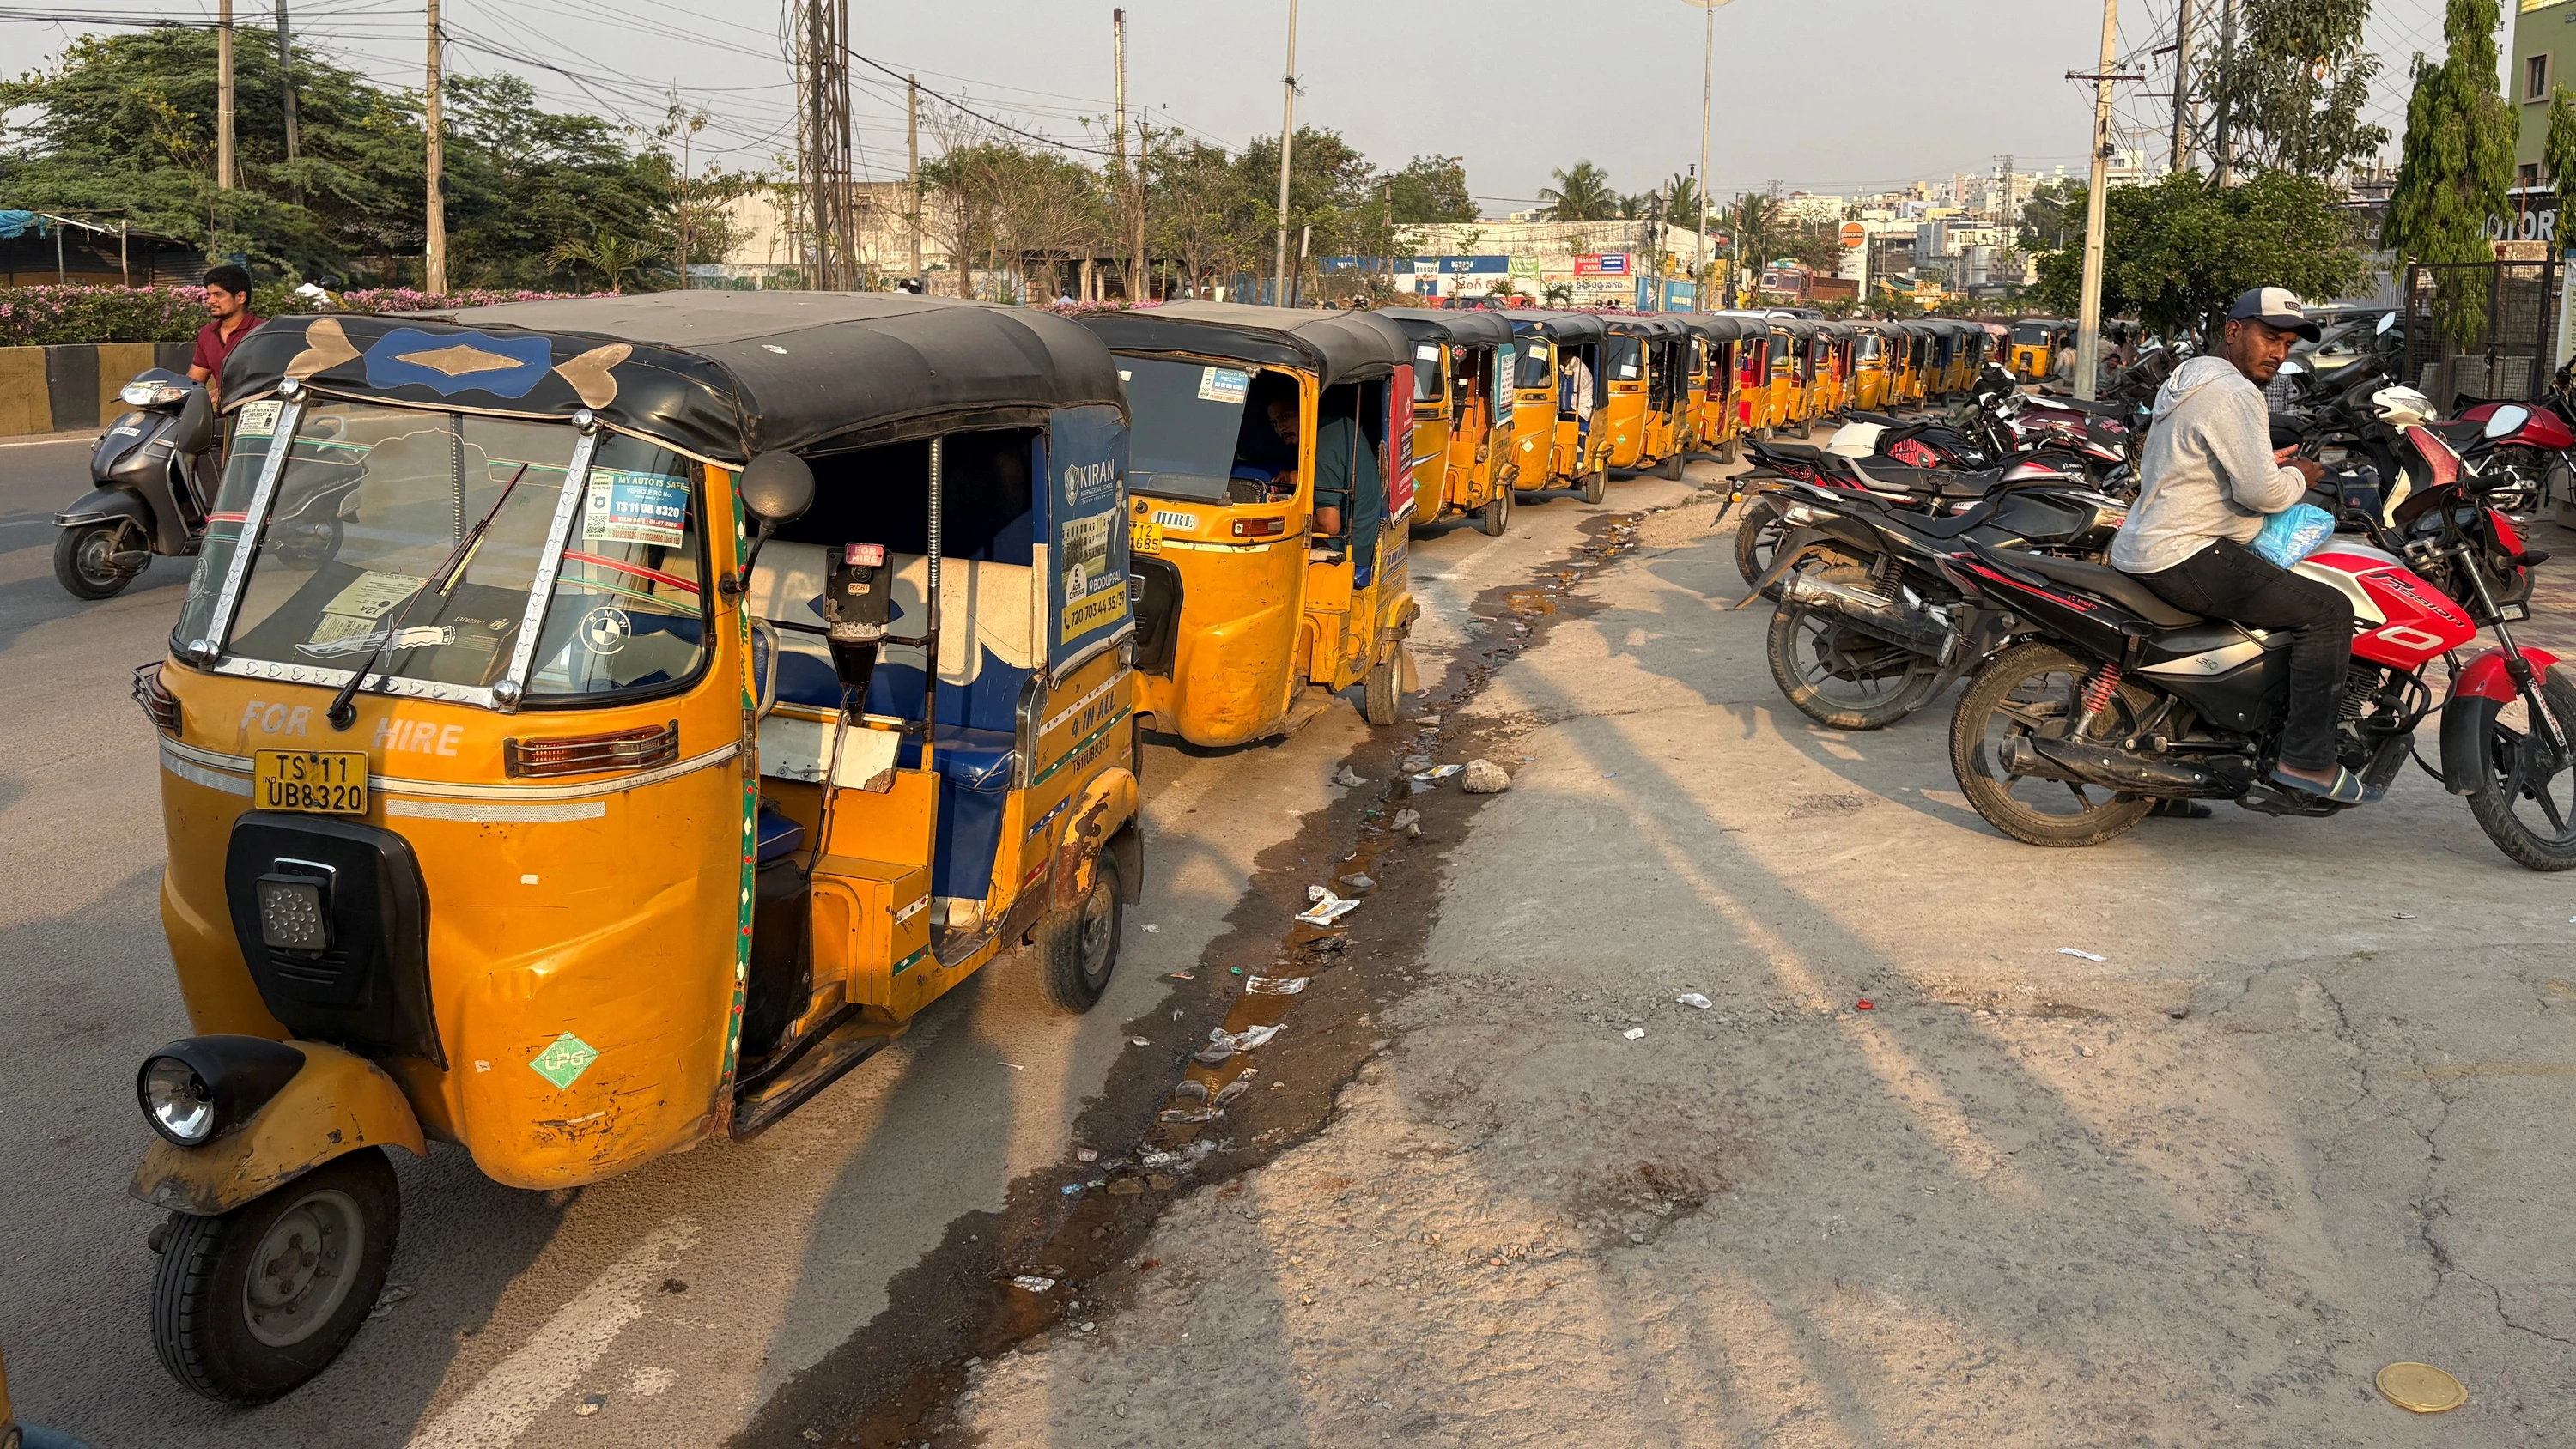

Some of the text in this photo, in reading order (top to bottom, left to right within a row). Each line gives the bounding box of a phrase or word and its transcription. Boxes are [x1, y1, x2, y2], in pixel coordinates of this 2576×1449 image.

[1080, 459, 1115, 488] KIRAN
[618, 476, 631, 484] MY
[632, 477, 655, 487] AUTO
[656, 479, 664, 488] IS
[666, 481, 685, 490] SAFE
[1102, 483, 1113, 492] SCHOOL
[626, 487, 653, 496] VEHICLE
[616, 501, 680, 518] TS 11 UB 8320
[1156, 512, 1194, 528] HIRE
[1140, 524, 1153, 537] 12
[854, 546, 877, 555] FOR
[852, 555, 878, 564] HIRE
[1074, 568, 1079, 583] 5
[1093, 570, 1121, 592] BODUPPAL
[1069, 587, 1084, 601] Campus
[1072, 583, 1081, 592] Acre
[453, 616, 487, 626] LASERJET
[1071, 608, 1084, 627] 720
[1084, 603, 1097, 621] 703
[1097, 599, 1107, 615] 44
[240, 700, 312, 737] FOR
[1072, 690, 1115, 738] 4 IN ALL
[371, 717, 464, 757] HIRE
[276, 754, 348, 782] TS 11
[269, 782, 362, 810] UB8320
[544, 1050, 586, 1070] LPG
